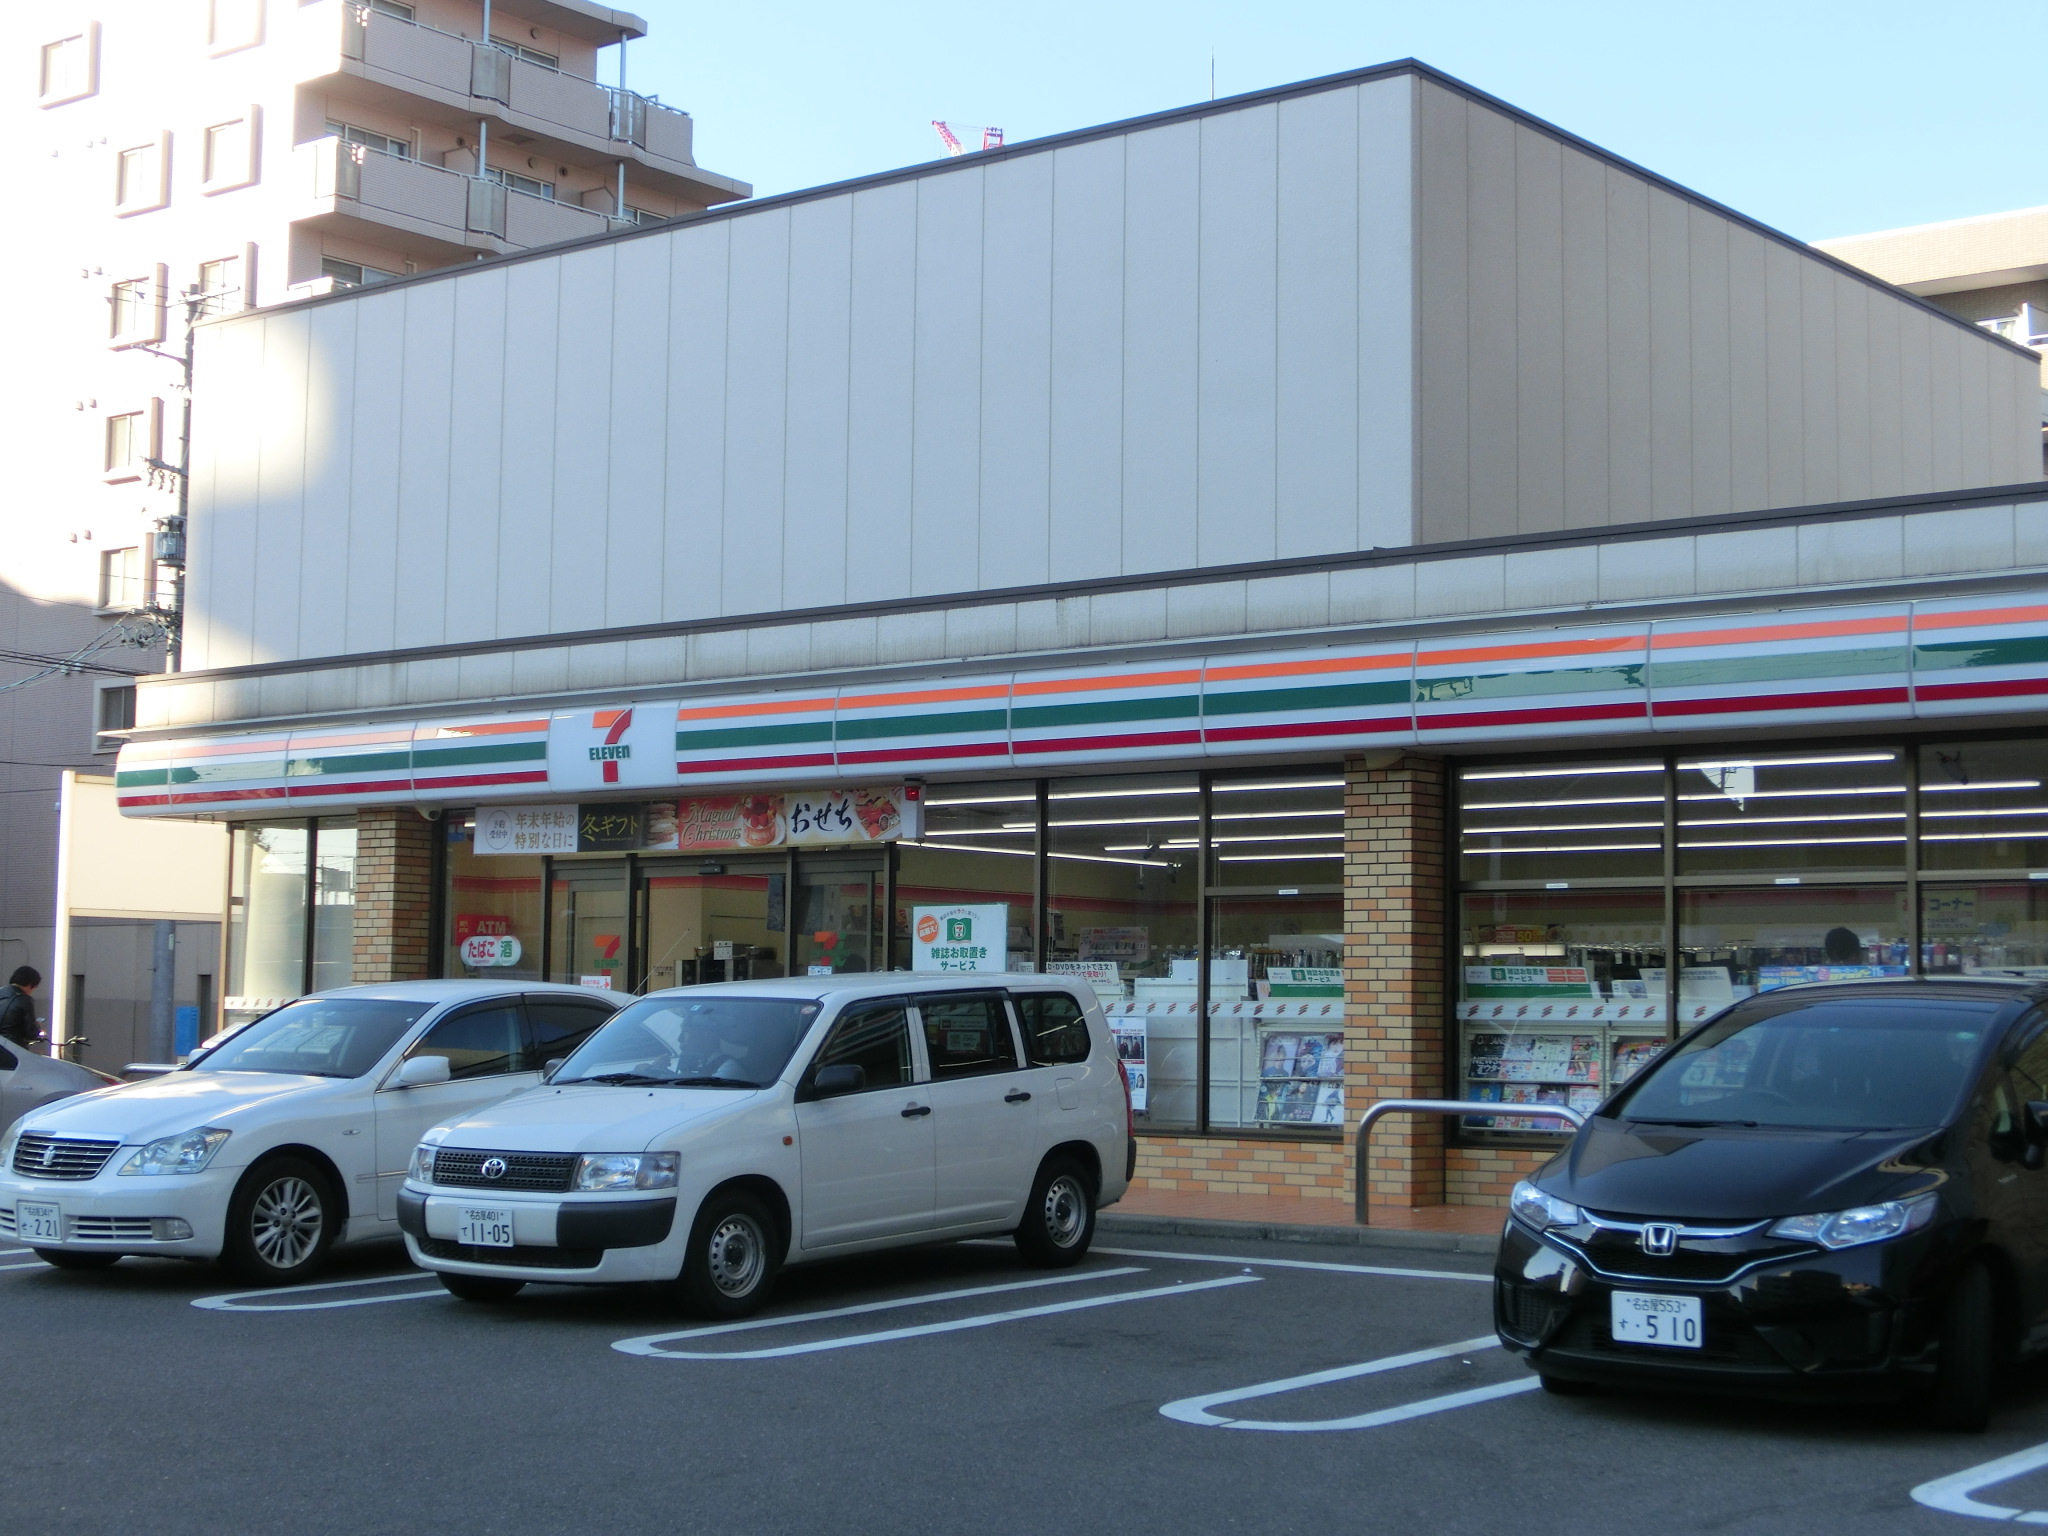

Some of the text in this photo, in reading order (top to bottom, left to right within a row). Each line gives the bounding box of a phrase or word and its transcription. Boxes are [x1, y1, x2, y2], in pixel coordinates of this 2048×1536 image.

[515, 811, 575, 830] 年末年始の
[682, 802, 738, 825] Magical
[791, 798, 852, 833] おせち
[489, 830, 508, 839] 受付中
[580, 813, 638, 842] 冬ギフト
[682, 822, 742, 846] Christmas
[514, 831, 574, 849] 特別な日に
[477, 921, 507, 934] ATM
[468, 940, 513, 958] たばこ 酒
[931, 946, 987, 959] 雑誌お取置き
[940, 960, 976, 971] サービス
[1508, 975, 1534, 983] サービス
[471, 1222, 510, 1243] 11-05
[1633, 1298, 1682, 1313] 名古屋553
